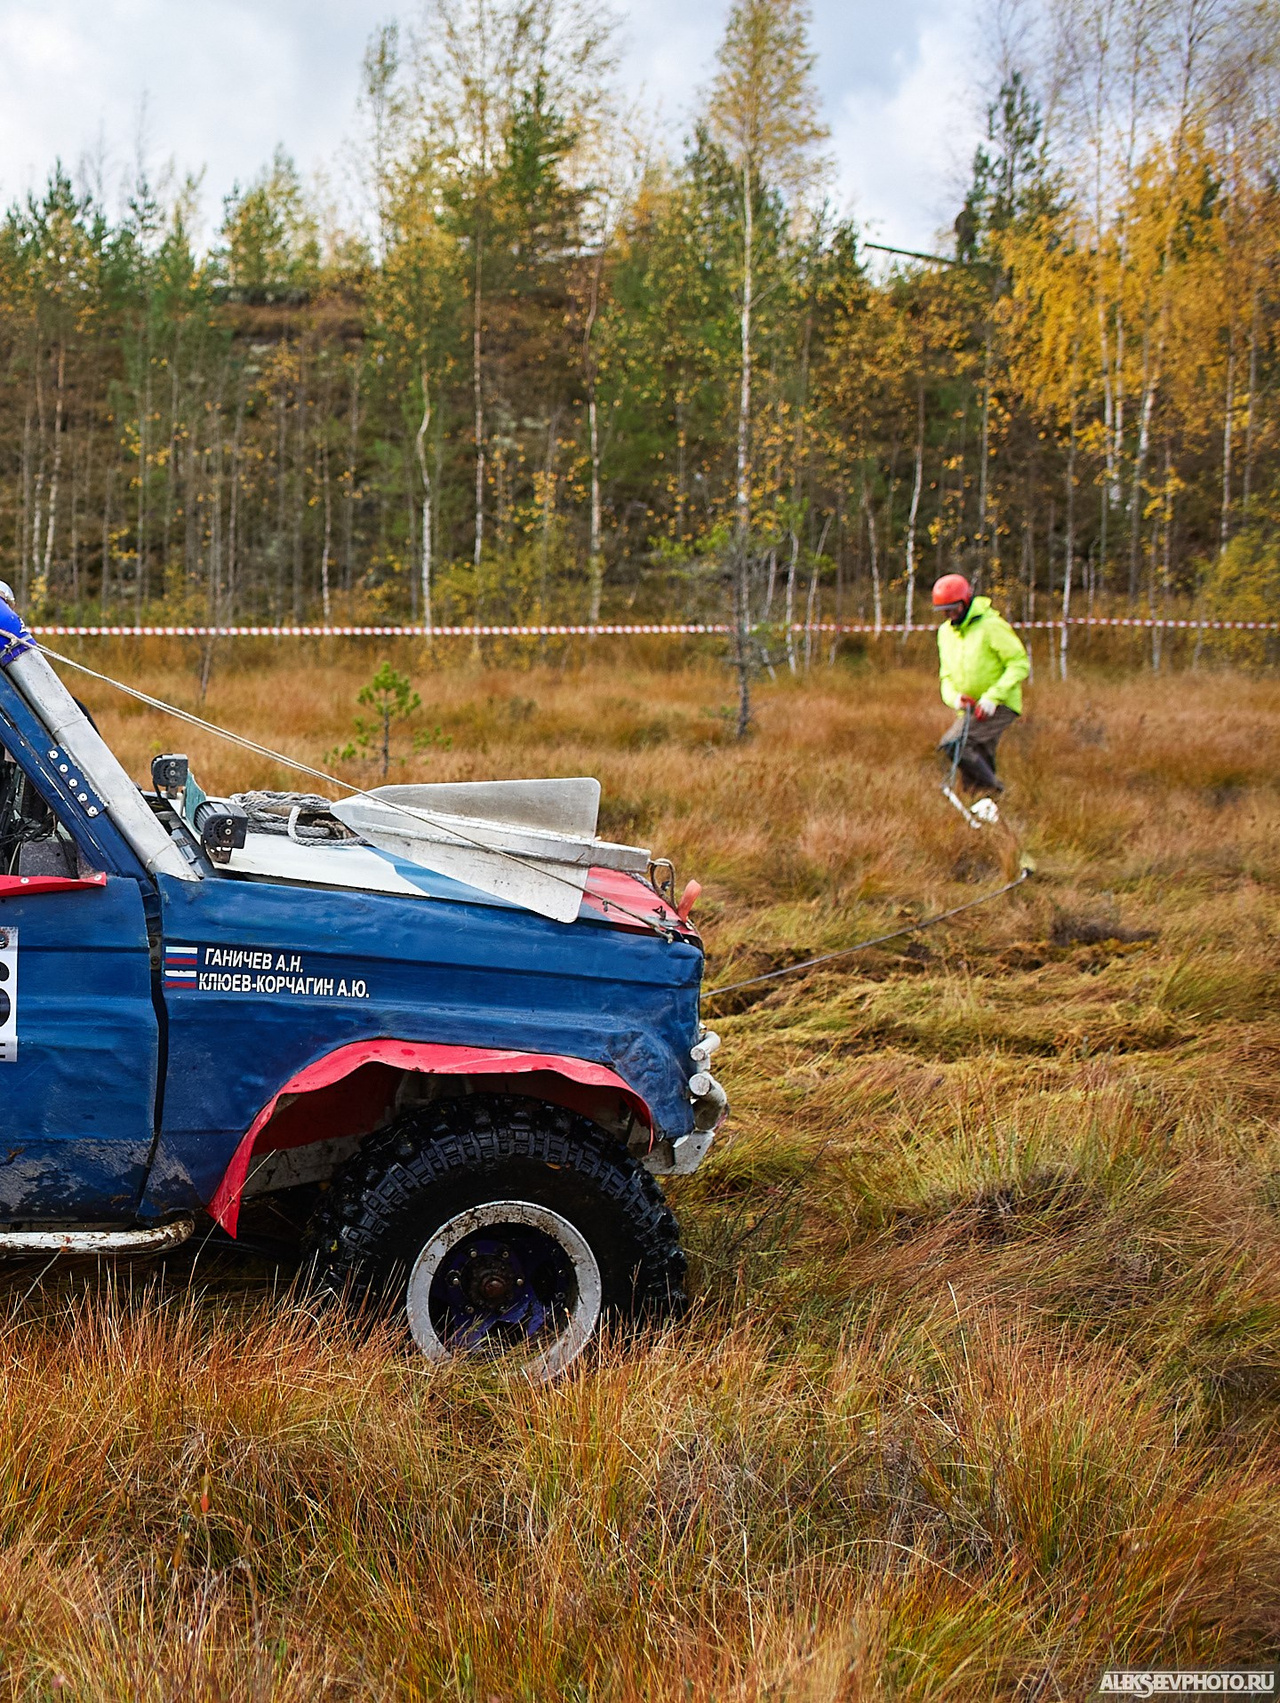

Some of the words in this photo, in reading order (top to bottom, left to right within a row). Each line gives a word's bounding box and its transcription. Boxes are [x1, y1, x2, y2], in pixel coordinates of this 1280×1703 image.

[204, 947, 272, 970] ГАНИЧЕВ
[275, 954, 304, 973] А.Н.
[198, 972, 334, 996] КЛЮЕВ-КОРЧАГИН
[336, 979, 370, 998] А.Ю.
